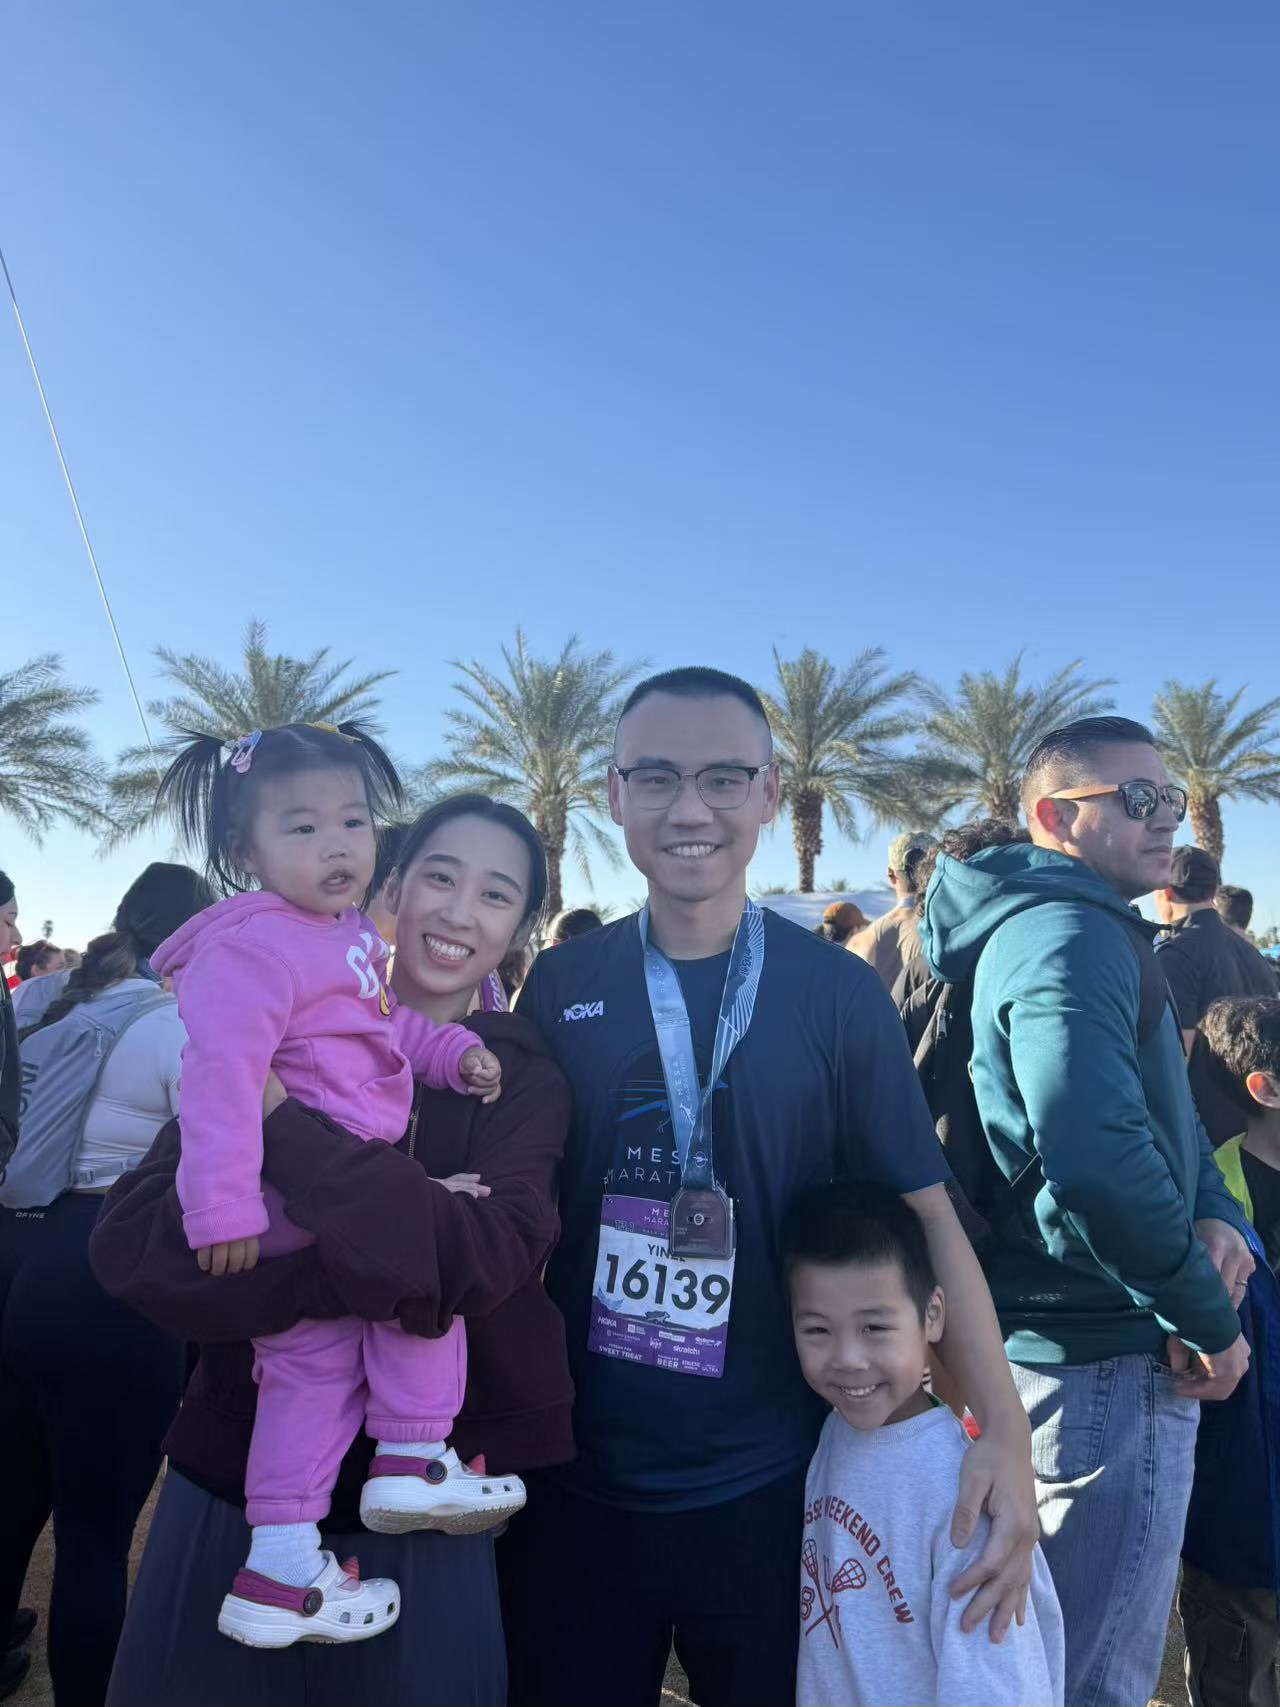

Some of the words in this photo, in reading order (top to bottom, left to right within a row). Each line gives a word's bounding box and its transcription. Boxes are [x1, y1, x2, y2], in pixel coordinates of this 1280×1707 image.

[672, 1060, 684, 1096] MESA
[626, 1146, 684, 1165] MES
[607, 1166, 728, 1193] MARATN
[643, 1215, 670, 1226] MARA
[652, 1207, 670, 1217] ME
[647, 1243, 686, 1262] YIN
[605, 1253, 731, 1315] 16139
[597, 1316, 617, 1328] HOKA
[599, 1345, 620, 1356] SWEET
[621, 1349, 642, 1361] TREAT
[657, 1357, 679, 1369] BEER
[876, 1555, 914, 1624] CREW
